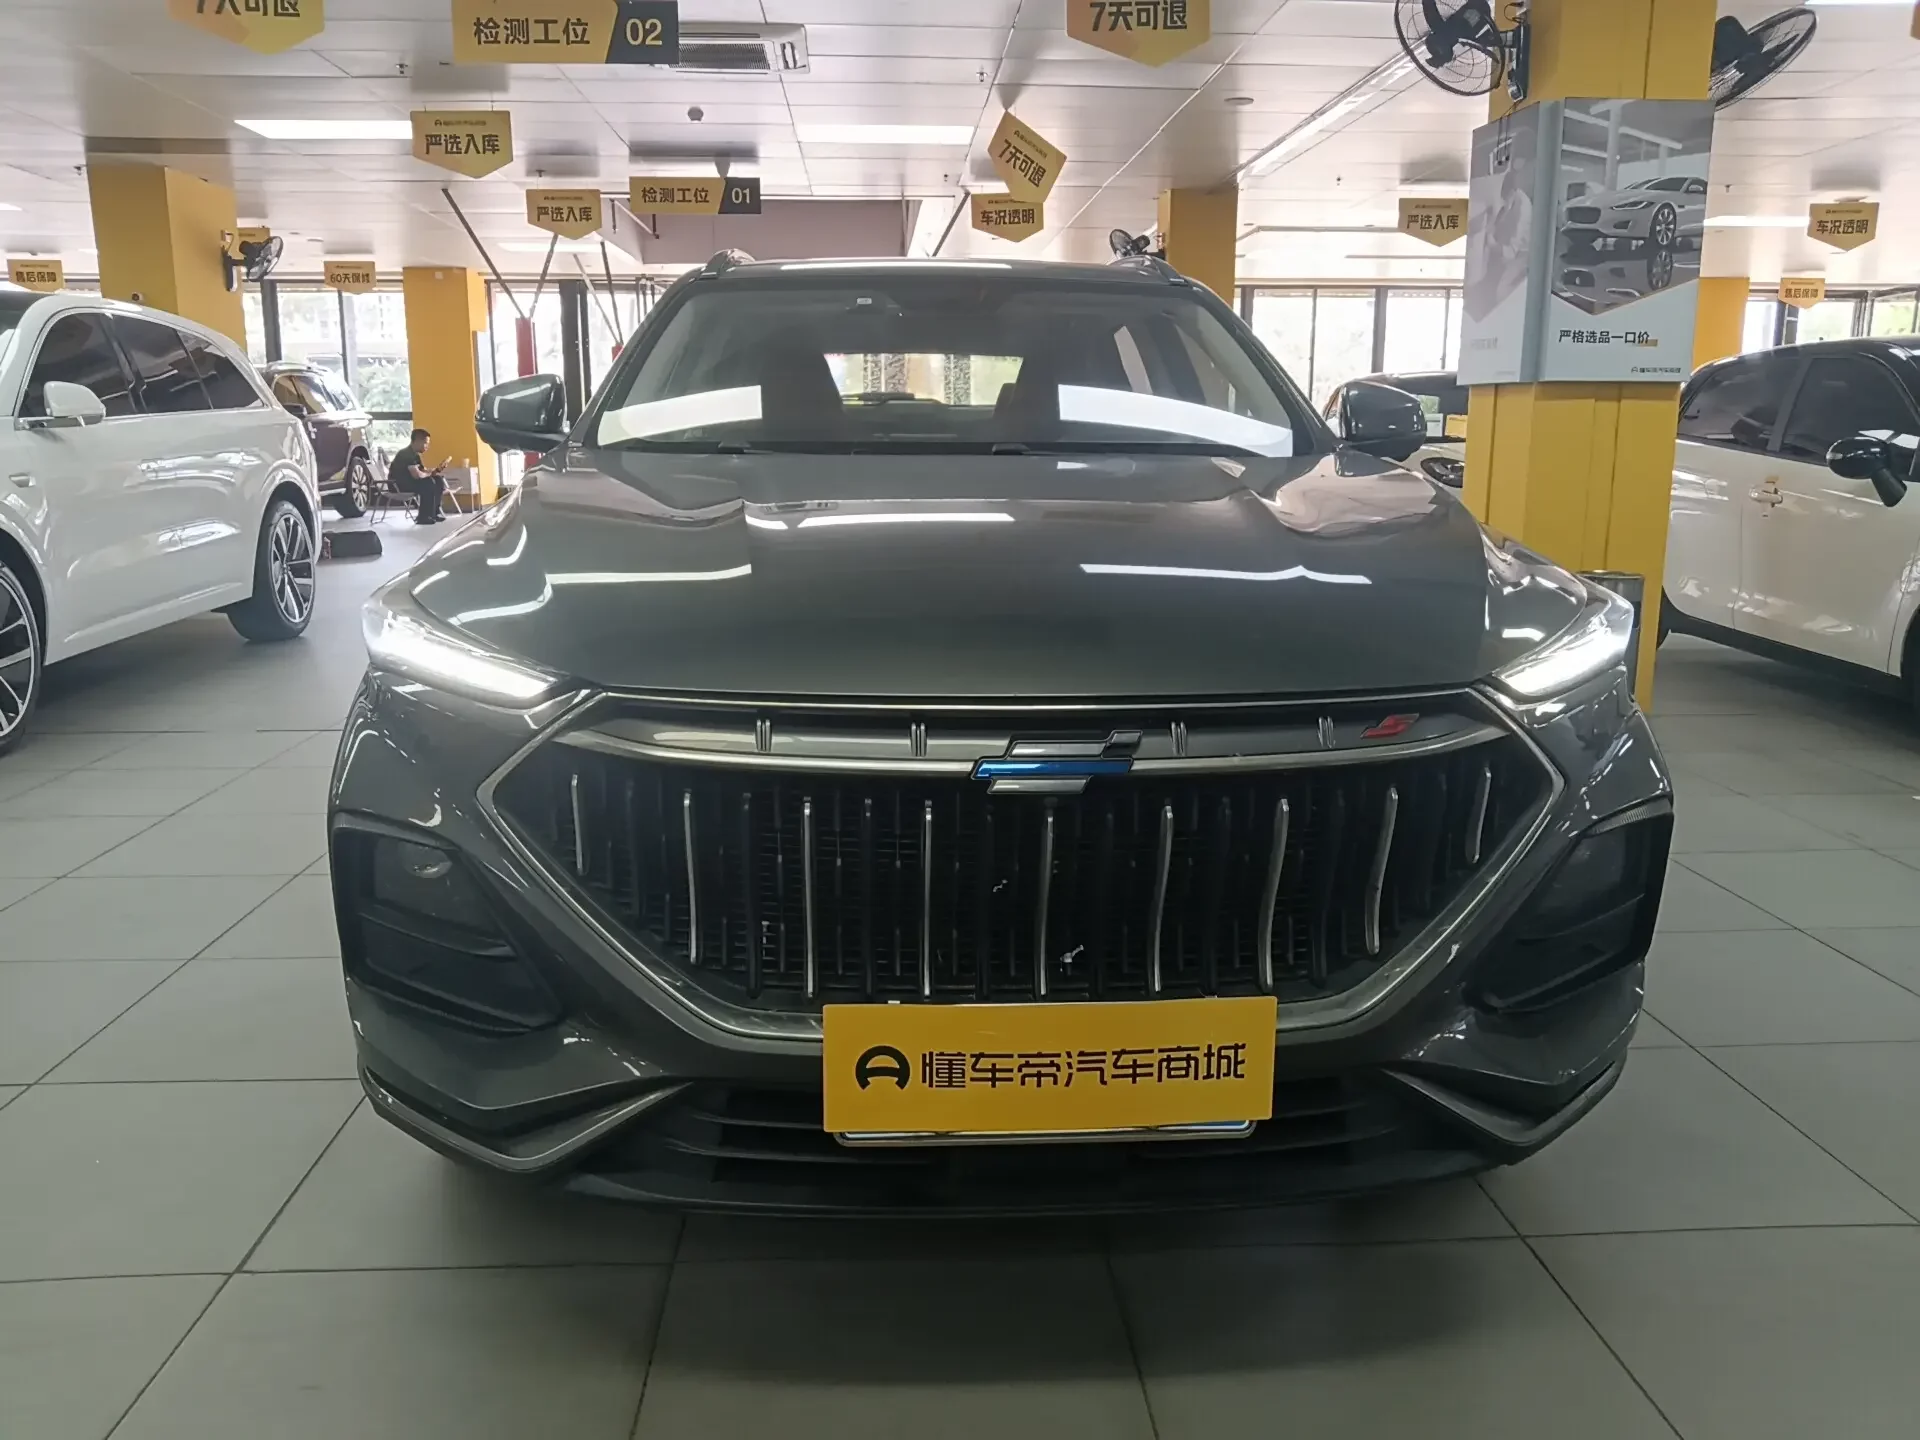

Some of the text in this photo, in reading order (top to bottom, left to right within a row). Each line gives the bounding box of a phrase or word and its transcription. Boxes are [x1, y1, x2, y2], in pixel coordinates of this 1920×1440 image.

[1089, 0, 1188, 32] 7天可退
[473, 17, 663, 46] 检测工位 02
[425, 133, 500, 155] 严选入库
[998, 138, 1047, 188] 7天可退
[641, 186, 752, 204] 检测工位 01
[536, 206, 593, 222] 严选入库
[980, 208, 1035, 226] 车况透明
[1406, 213, 1460, 230] 严选入库
[1816, 219, 1869, 235] 车况透明
[1558, 329, 1651, 344] 严格选品一口价
[921, 1043, 1247, 1089] 懂车帝汽车商城
